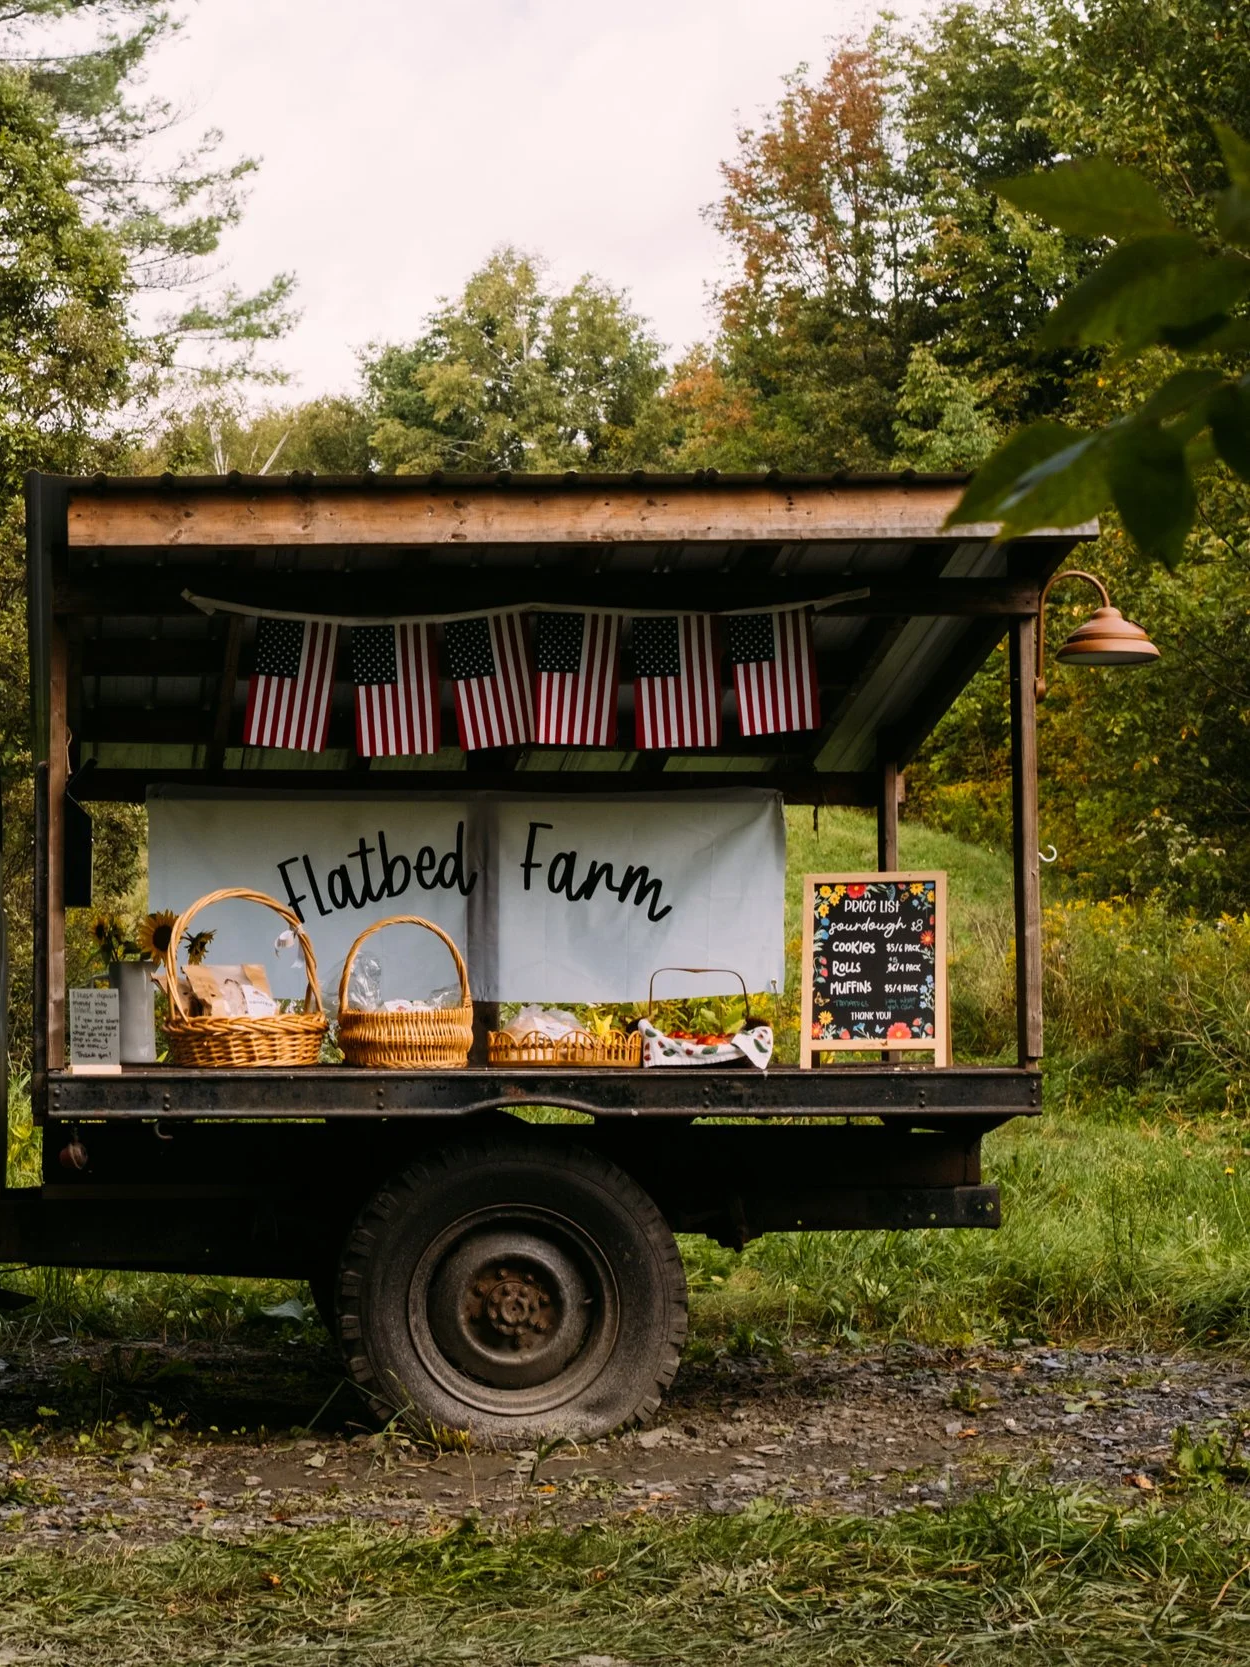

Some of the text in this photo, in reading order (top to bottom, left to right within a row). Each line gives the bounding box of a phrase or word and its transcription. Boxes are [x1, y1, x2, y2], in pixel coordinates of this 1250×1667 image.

[277, 821, 672, 923] Flatbed Farm
[828, 916, 924, 938] sourdough $8
[904, 942, 921, 953] PACK
[905, 962, 921, 973] PACK
[830, 980, 872, 996] MUFFINS
[902, 983, 918, 993] PACK
